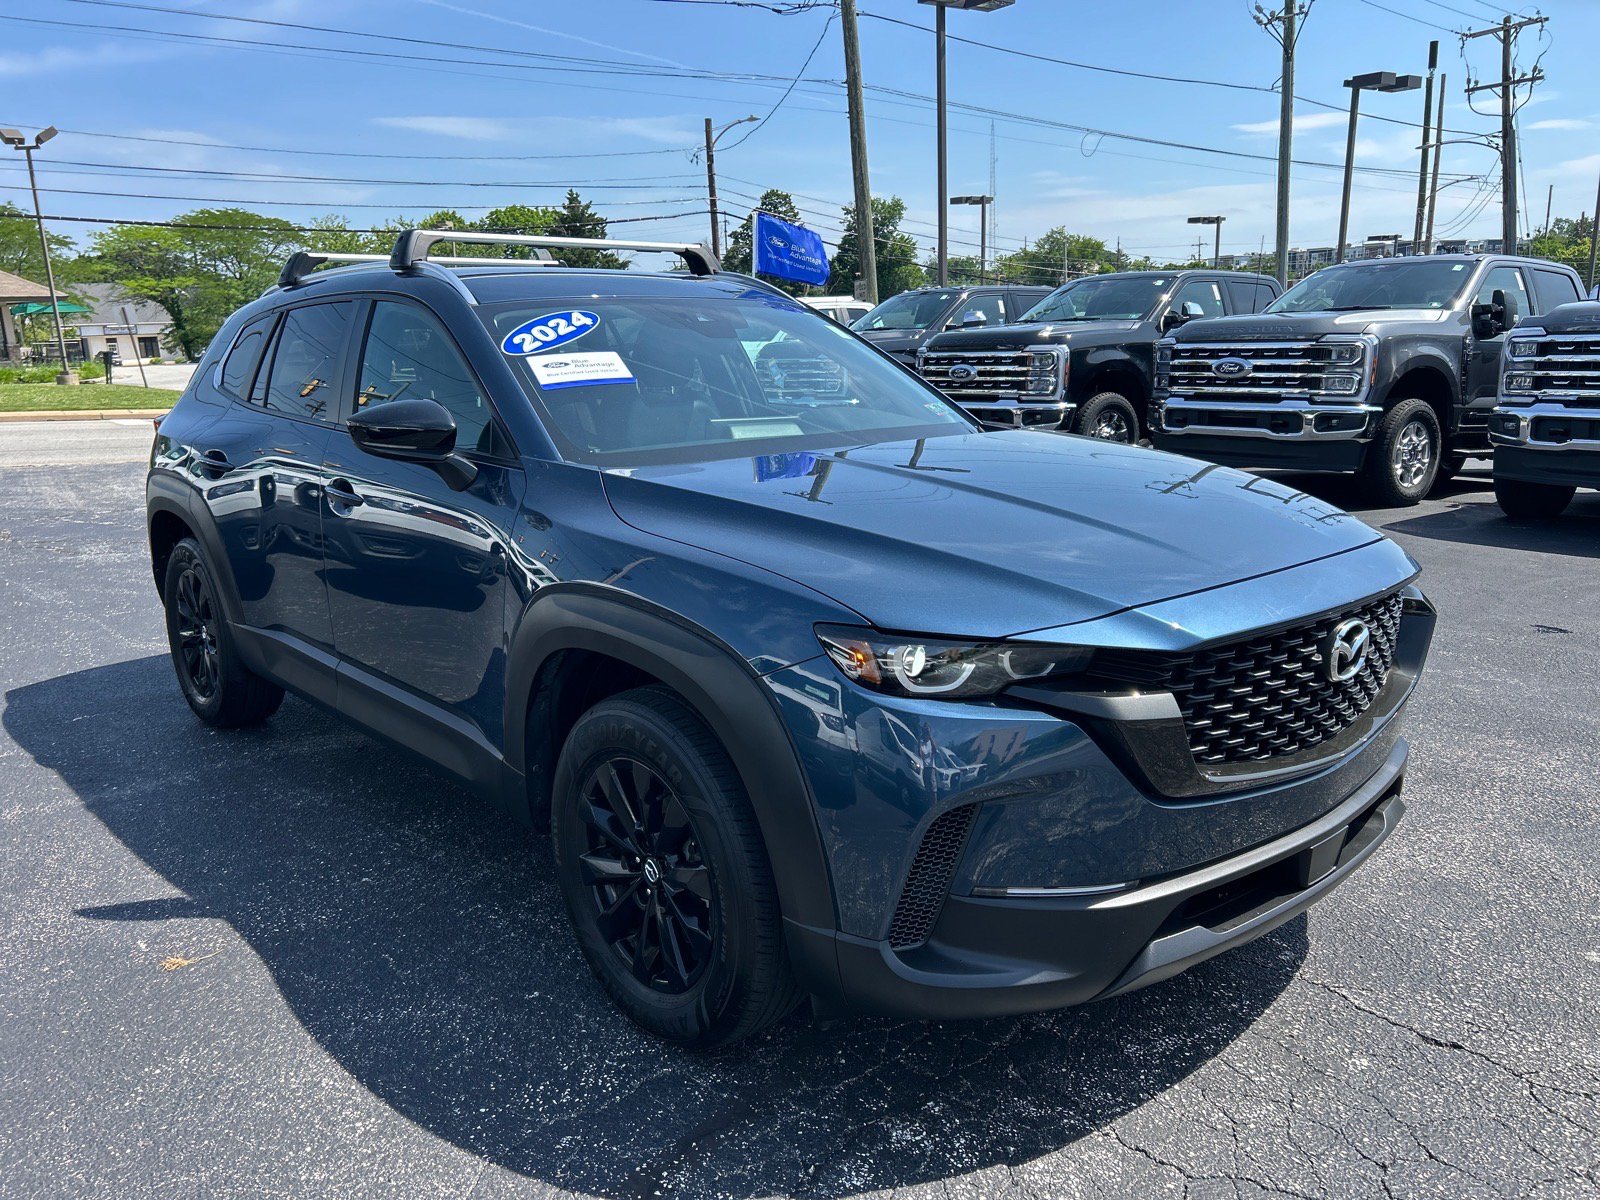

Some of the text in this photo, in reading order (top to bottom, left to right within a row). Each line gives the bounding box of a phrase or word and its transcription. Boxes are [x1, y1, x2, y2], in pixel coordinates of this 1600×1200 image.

[791, 245, 805, 253] Blue
[790, 252, 821, 265] Advantage
[512, 311, 593, 352] 2024
[1220, 363, 1239, 372] Ford
[953, 369, 968, 377] Ford
